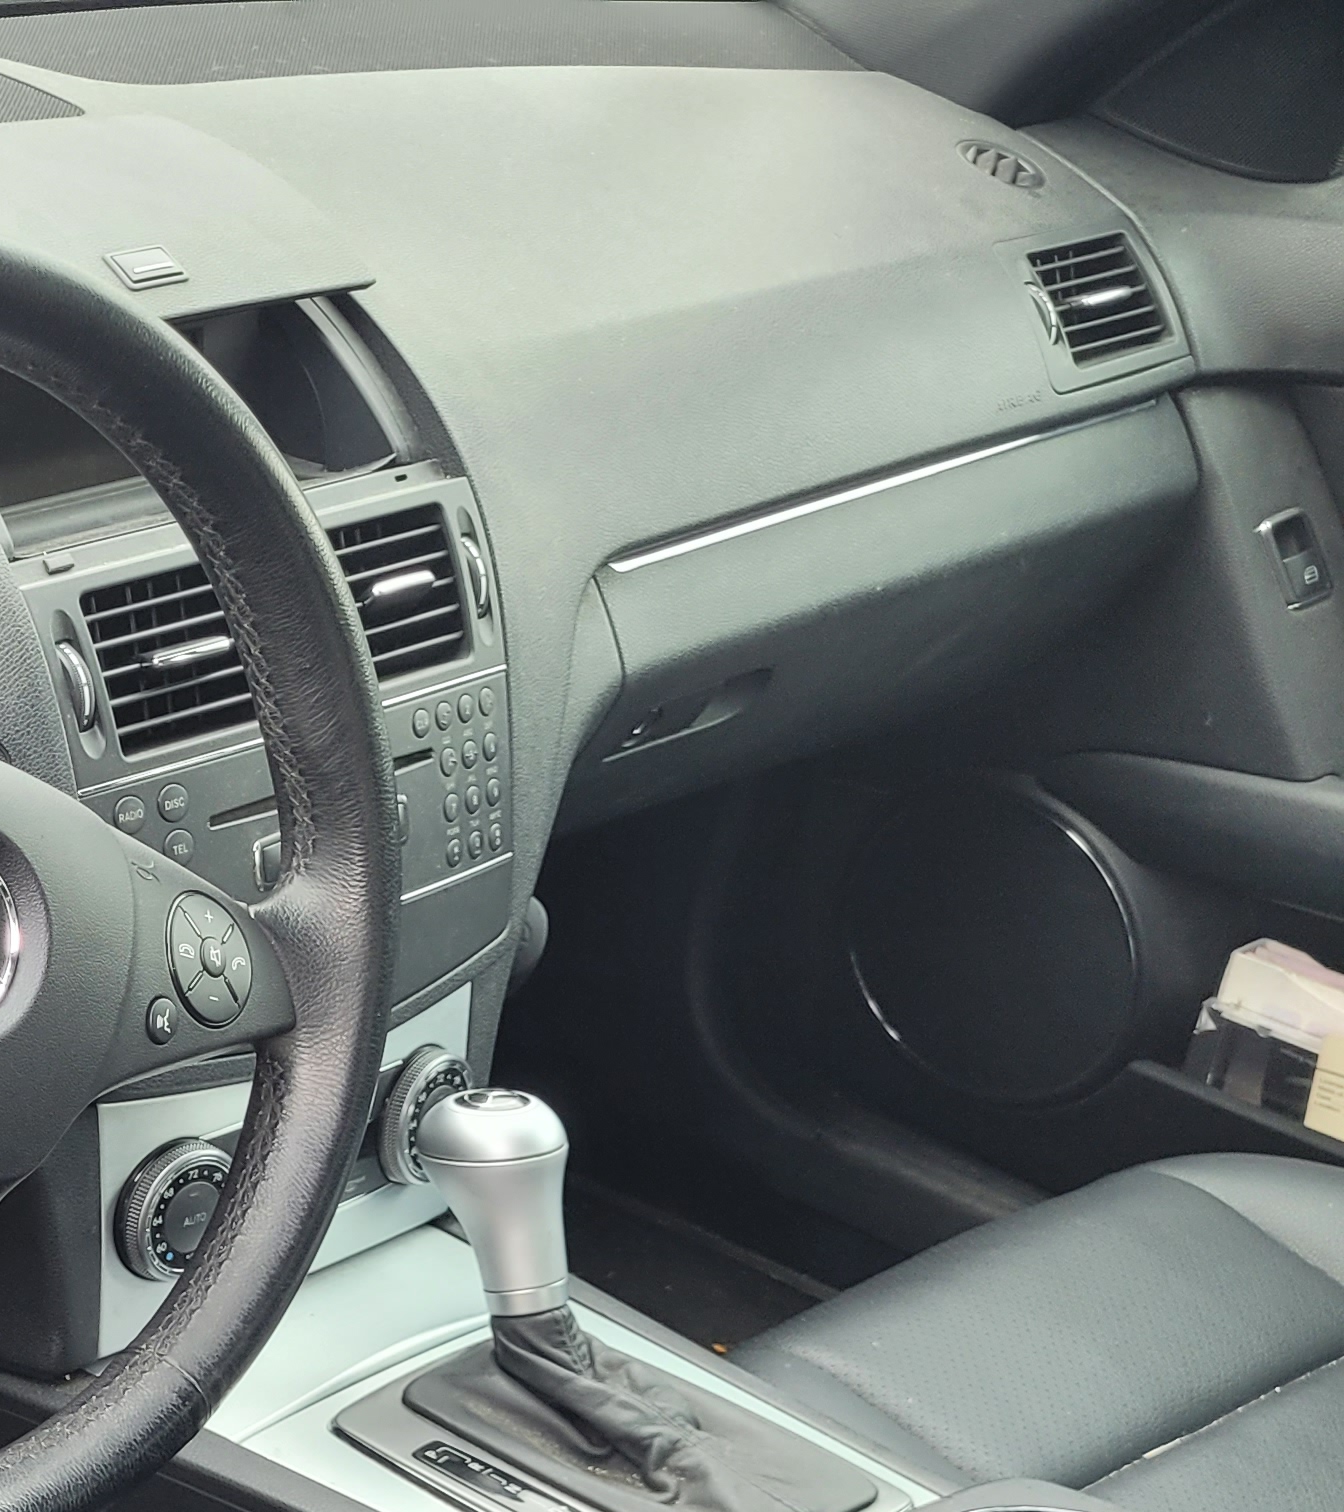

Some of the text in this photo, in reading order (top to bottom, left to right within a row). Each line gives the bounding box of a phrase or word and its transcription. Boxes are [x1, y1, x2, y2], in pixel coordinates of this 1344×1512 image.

[164, 796, 185, 811] DISC
[119, 809, 144, 823] RADIO
[173, 842, 188, 855] TEL
[188, 1170, 199, 1180] 72
[183, 1212, 207, 1227] AUTO
